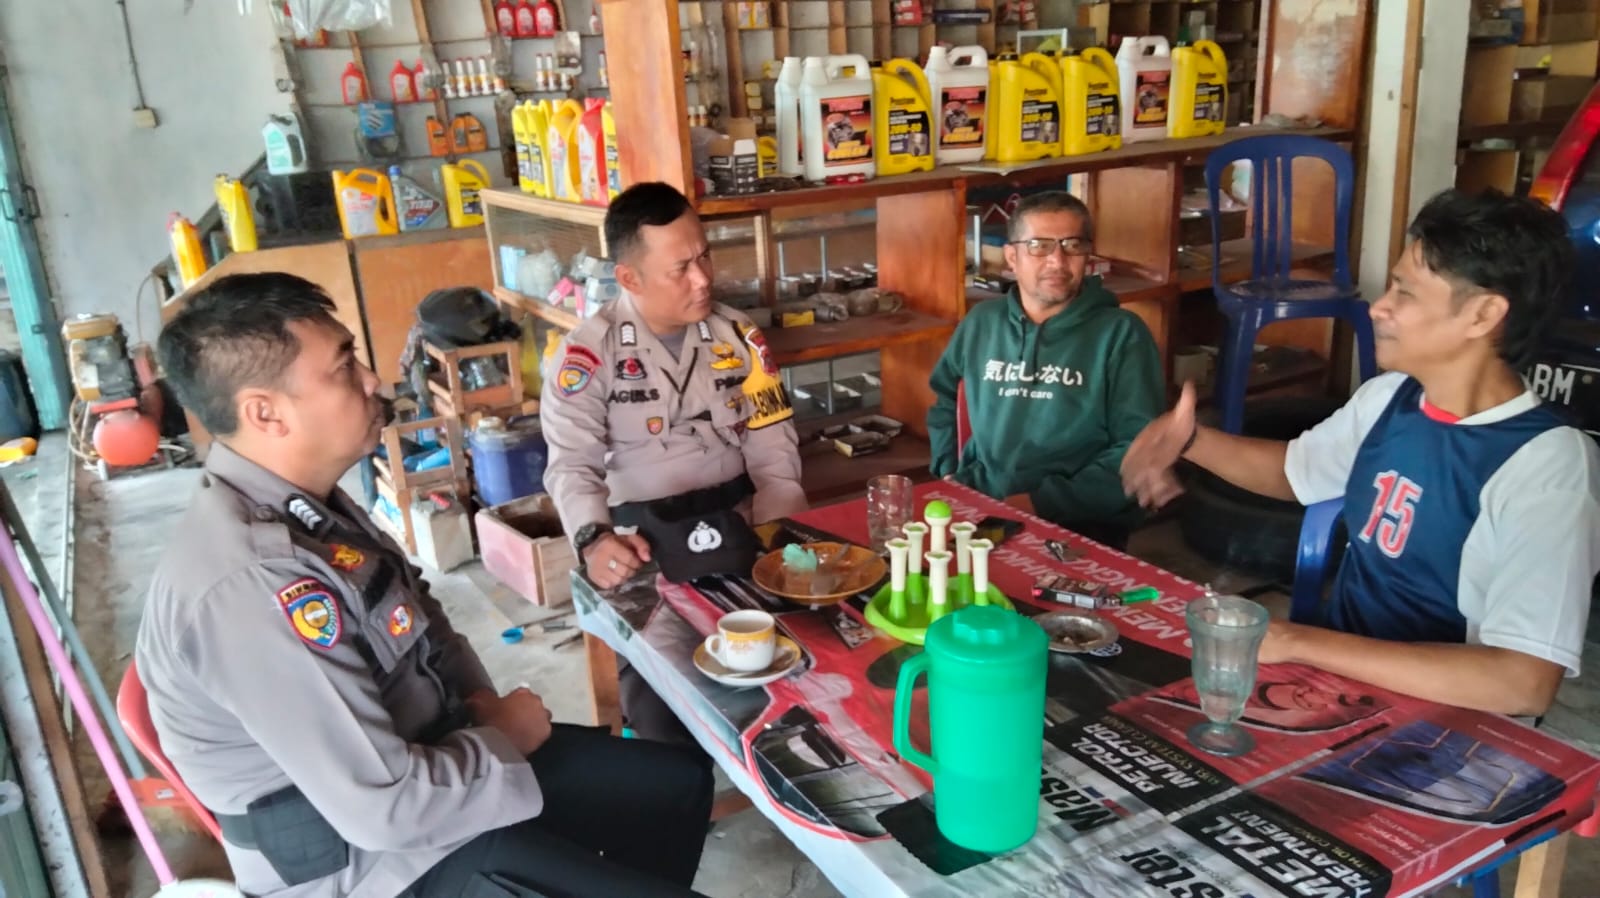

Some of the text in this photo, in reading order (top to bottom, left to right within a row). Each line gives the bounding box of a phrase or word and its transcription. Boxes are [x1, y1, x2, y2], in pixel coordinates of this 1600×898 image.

[1532, 363, 1577, 406] BM
[1357, 469, 1424, 560] 15
[1071, 736, 1165, 793] PETROL
[1083, 722, 1200, 789] INJECTOR
[1200, 814, 1345, 897] METAL
[1231, 810, 1373, 897] TREATMENT
